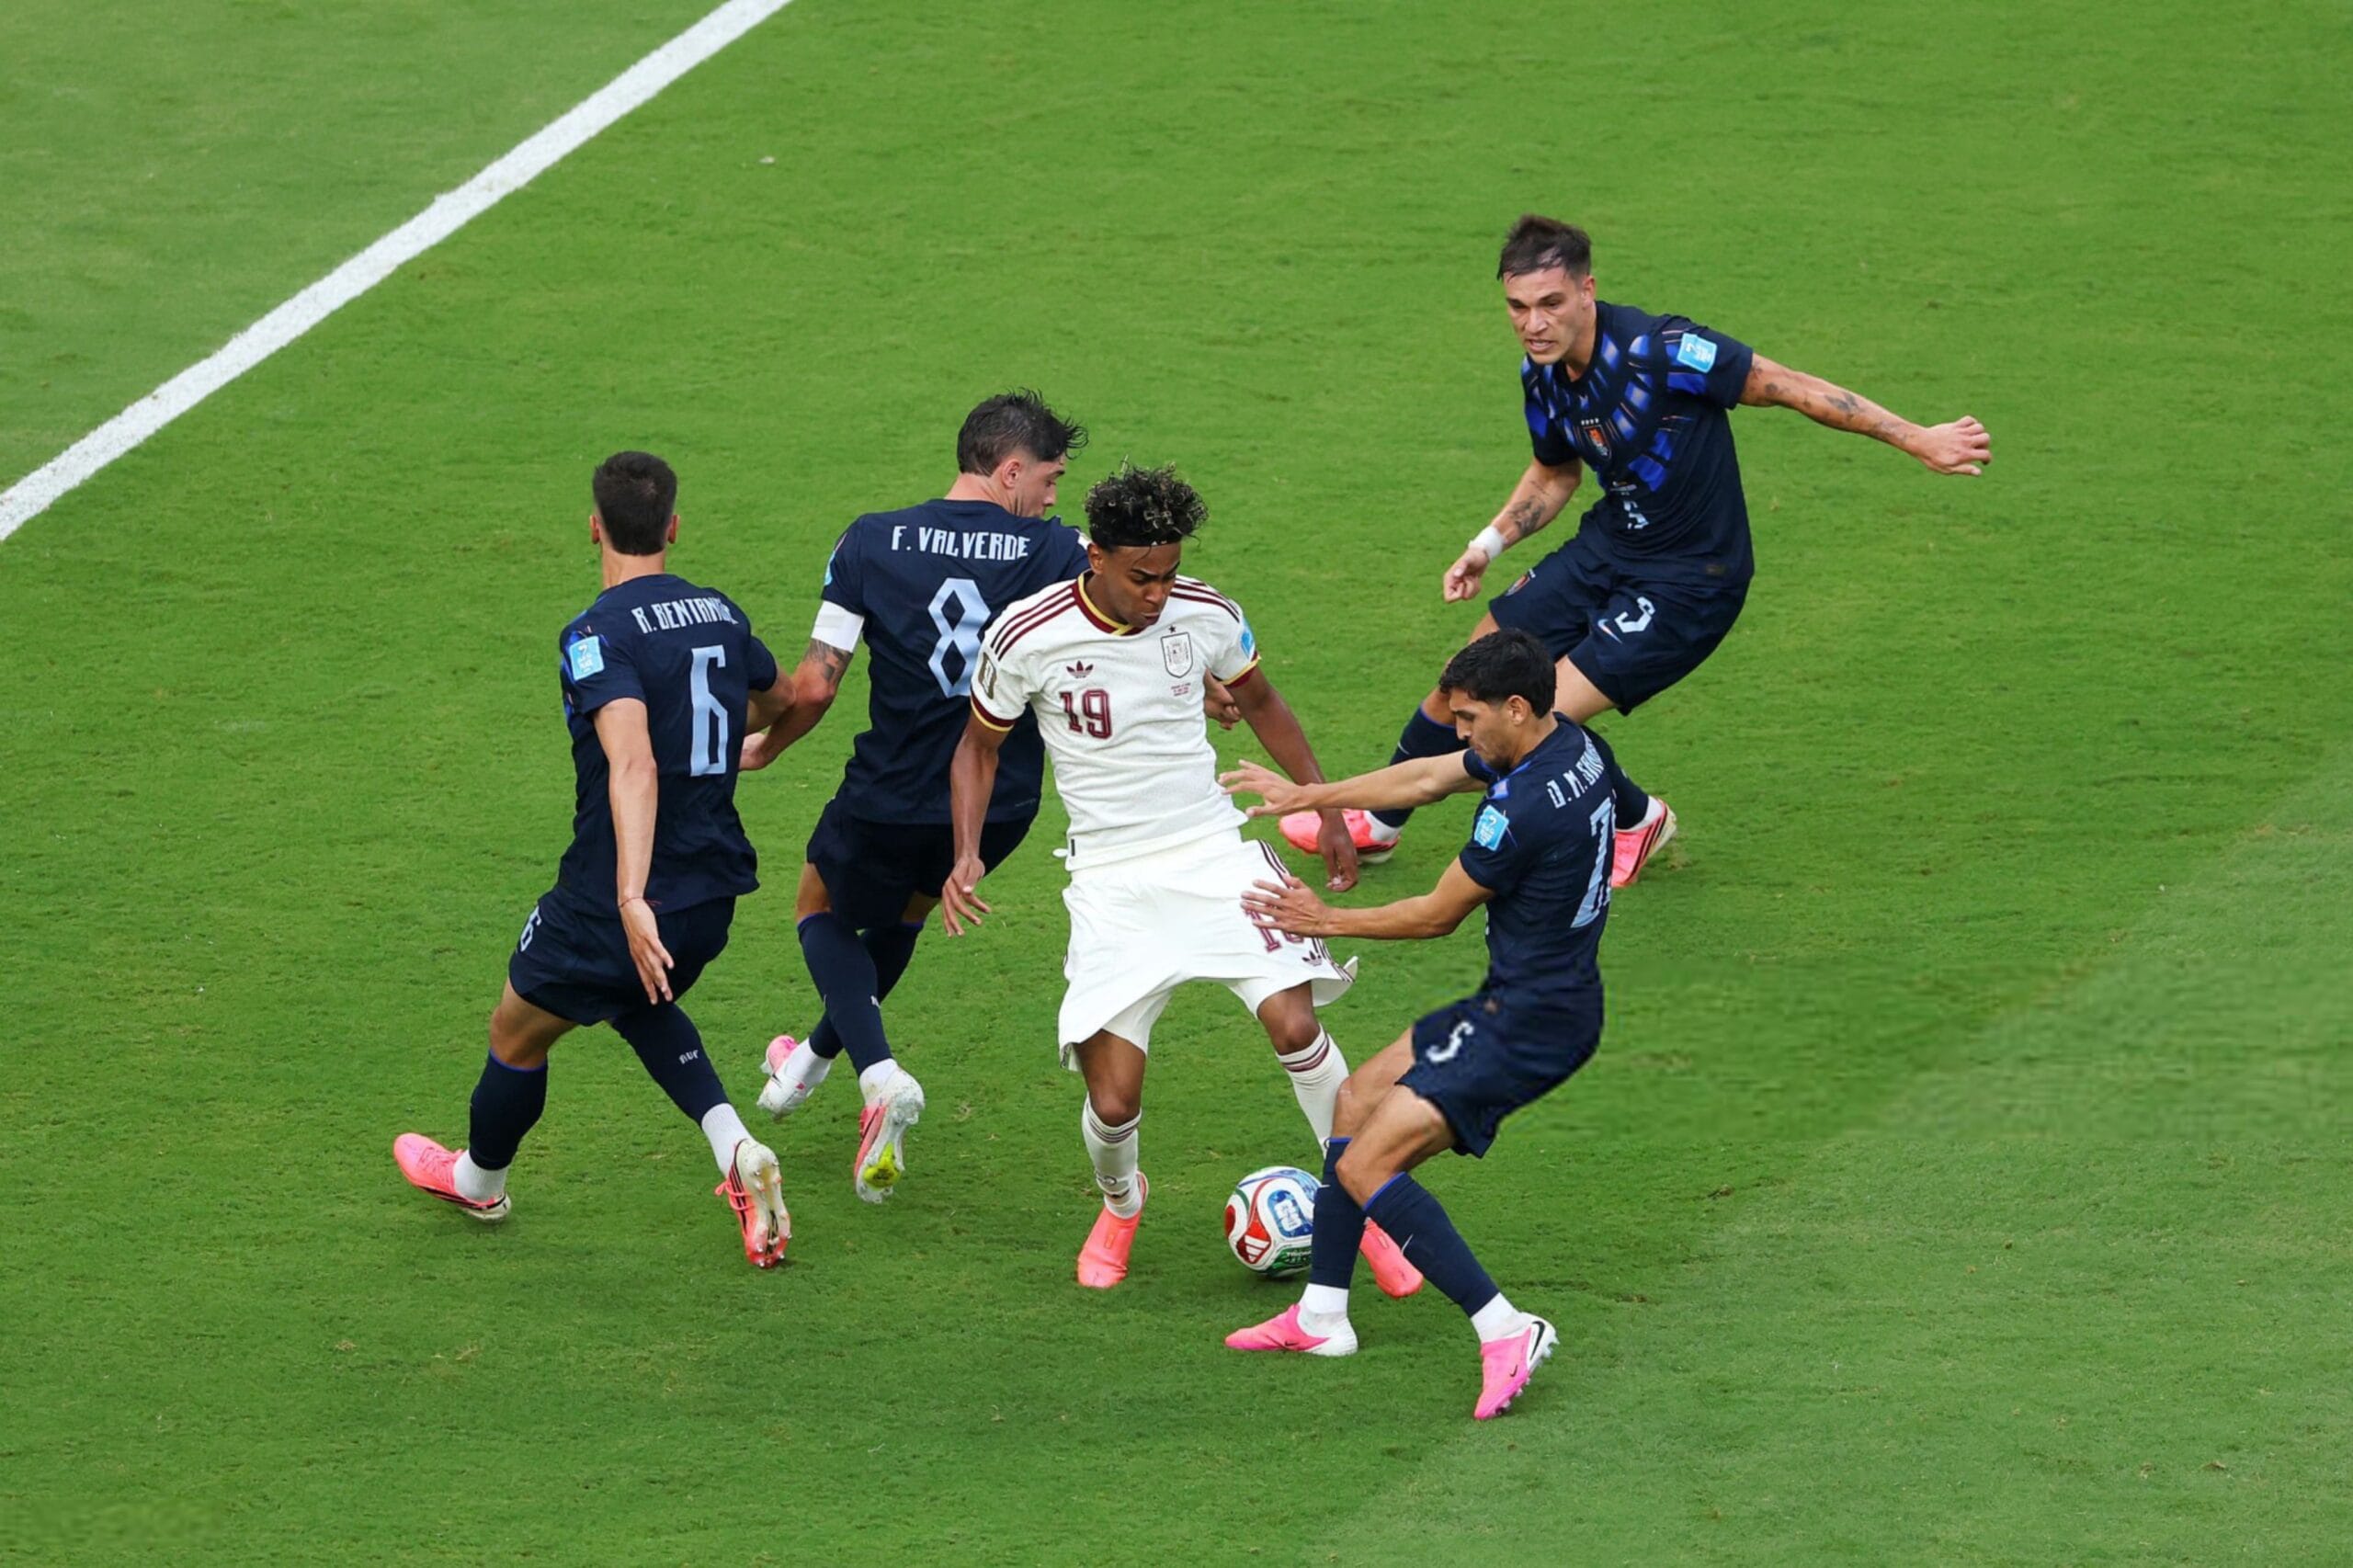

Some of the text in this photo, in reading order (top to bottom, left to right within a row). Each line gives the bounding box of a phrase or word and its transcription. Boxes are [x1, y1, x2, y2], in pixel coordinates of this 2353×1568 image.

[891, 525, 1032, 562] F. VALVERDE
[927, 577, 992, 699] 8
[689, 644, 729, 776] 6
[1058, 689, 1114, 741] 19
[520, 904, 542, 953] 6
[678, 1050, 699, 1065] AUF
